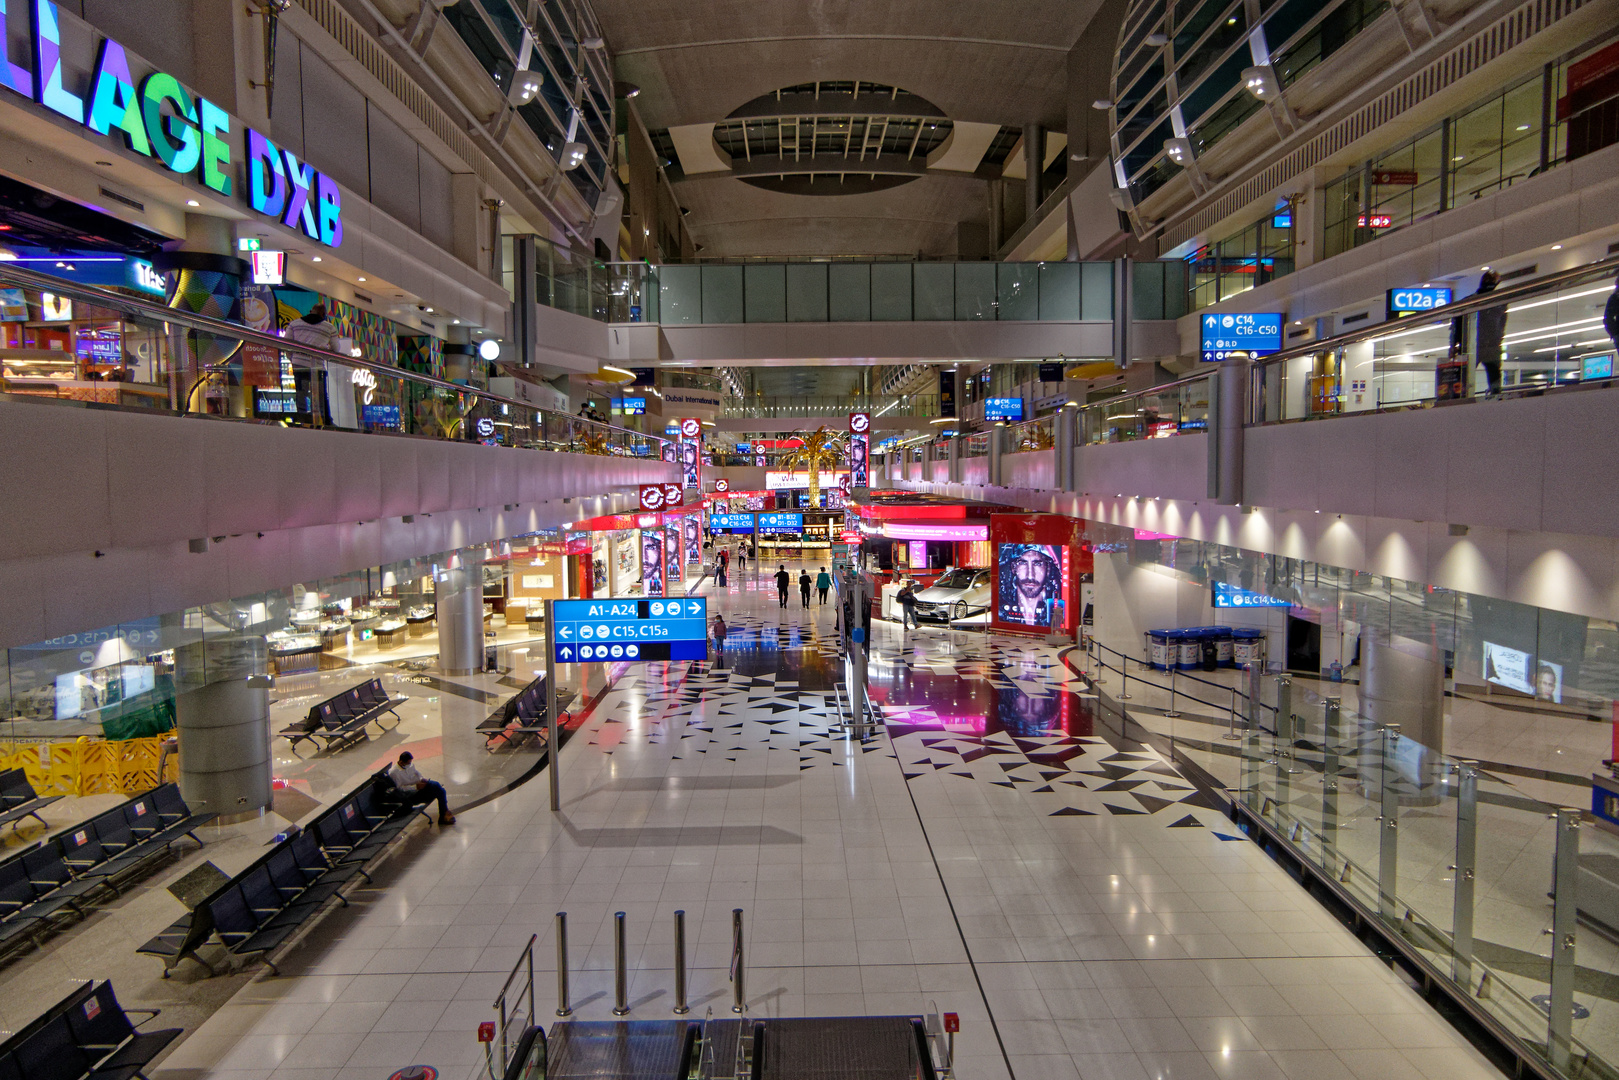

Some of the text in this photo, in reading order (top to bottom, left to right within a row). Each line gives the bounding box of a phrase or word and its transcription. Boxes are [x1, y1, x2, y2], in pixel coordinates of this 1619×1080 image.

[245, 127, 343, 248] DXB
[1394, 292, 1432, 308] C12a
[1235, 315, 1256, 325] C14,
[665, 394, 684, 402] Dubai
[685, 396, 713, 405] International
[1003, 604, 1042, 614] OCEAN
[639, 625, 668, 636] C15a
